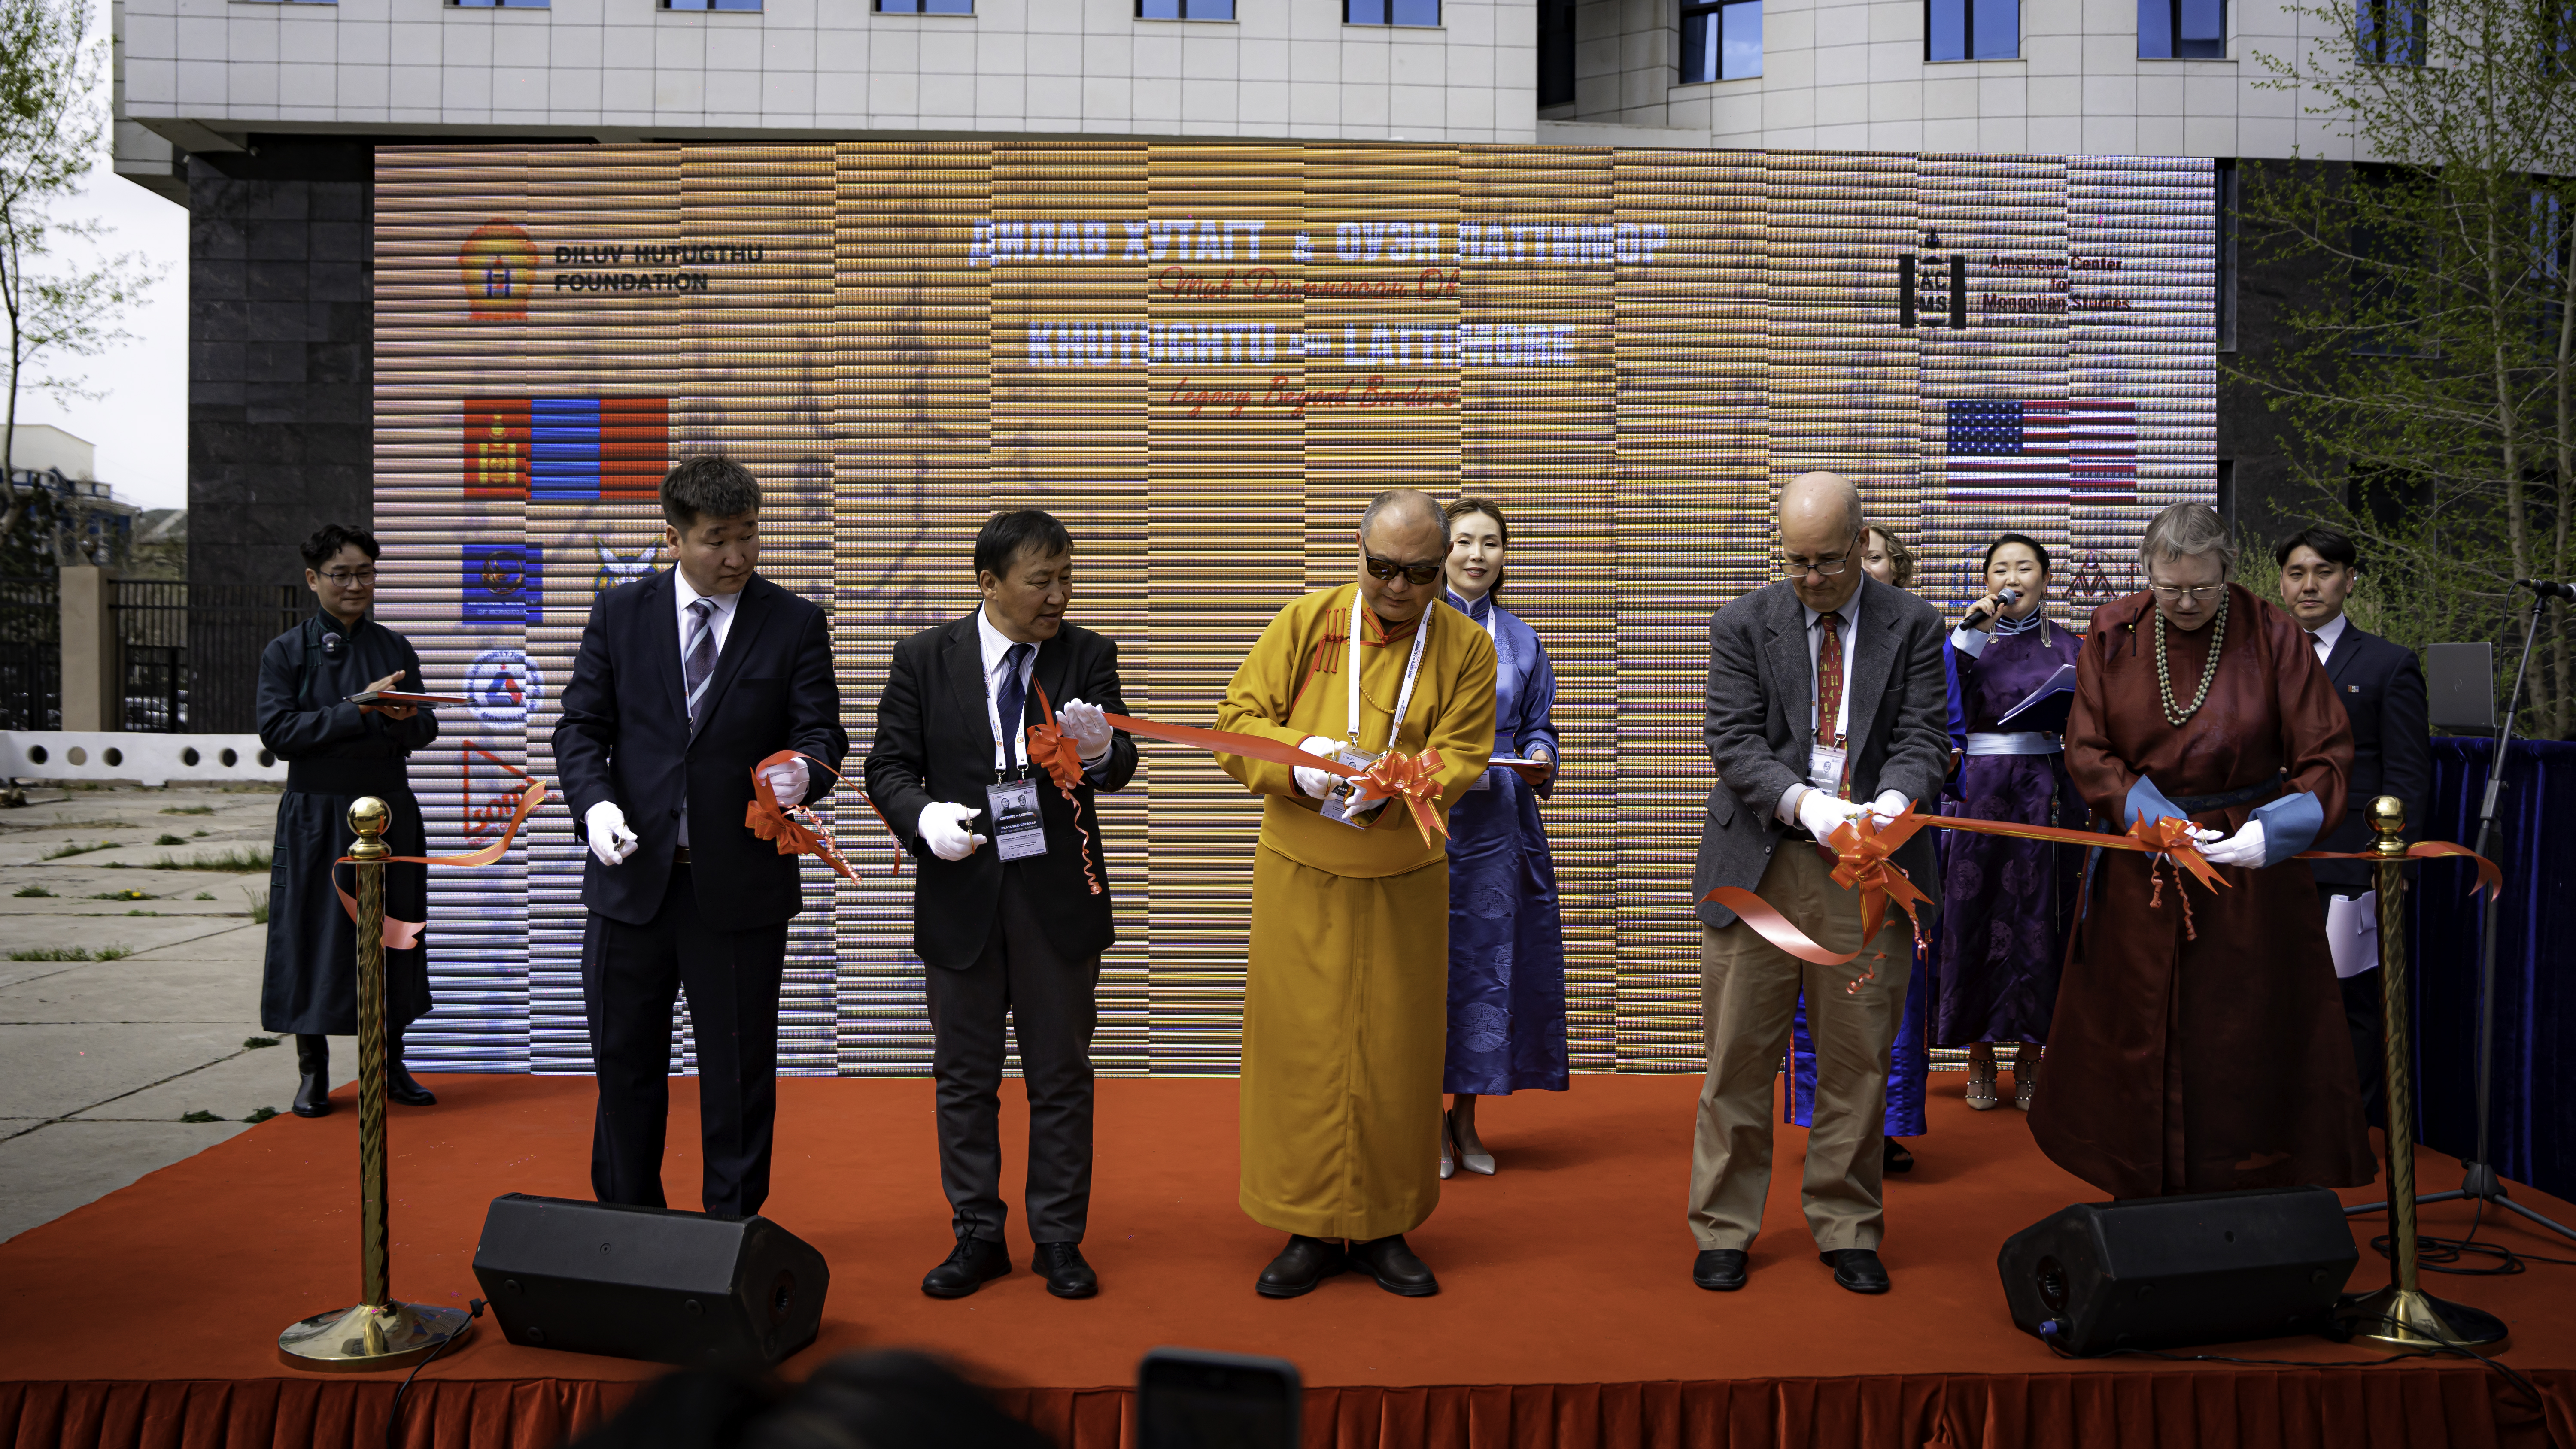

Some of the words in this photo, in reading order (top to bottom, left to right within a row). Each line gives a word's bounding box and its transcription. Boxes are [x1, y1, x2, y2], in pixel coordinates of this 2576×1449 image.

[1337, 221, 1439, 259] ОУЭН
[555, 246, 624, 264] DILUV
[635, 245, 763, 264] HUTUGTHU
[1990, 255, 2065, 270] American
[2071, 256, 2122, 271] Center
[555, 273, 708, 292] FOUNDATION
[2051, 274, 2072, 292] for
[1983, 294, 2066, 313] Mongolian
[2072, 294, 2131, 309] Studies
[1028, 321, 1276, 366] KHUTUGHTU
[1344, 322, 1575, 366] LATTIMORE
[1169, 376, 1250, 418] Legacy
[1263, 375, 1354, 418] Beyond
